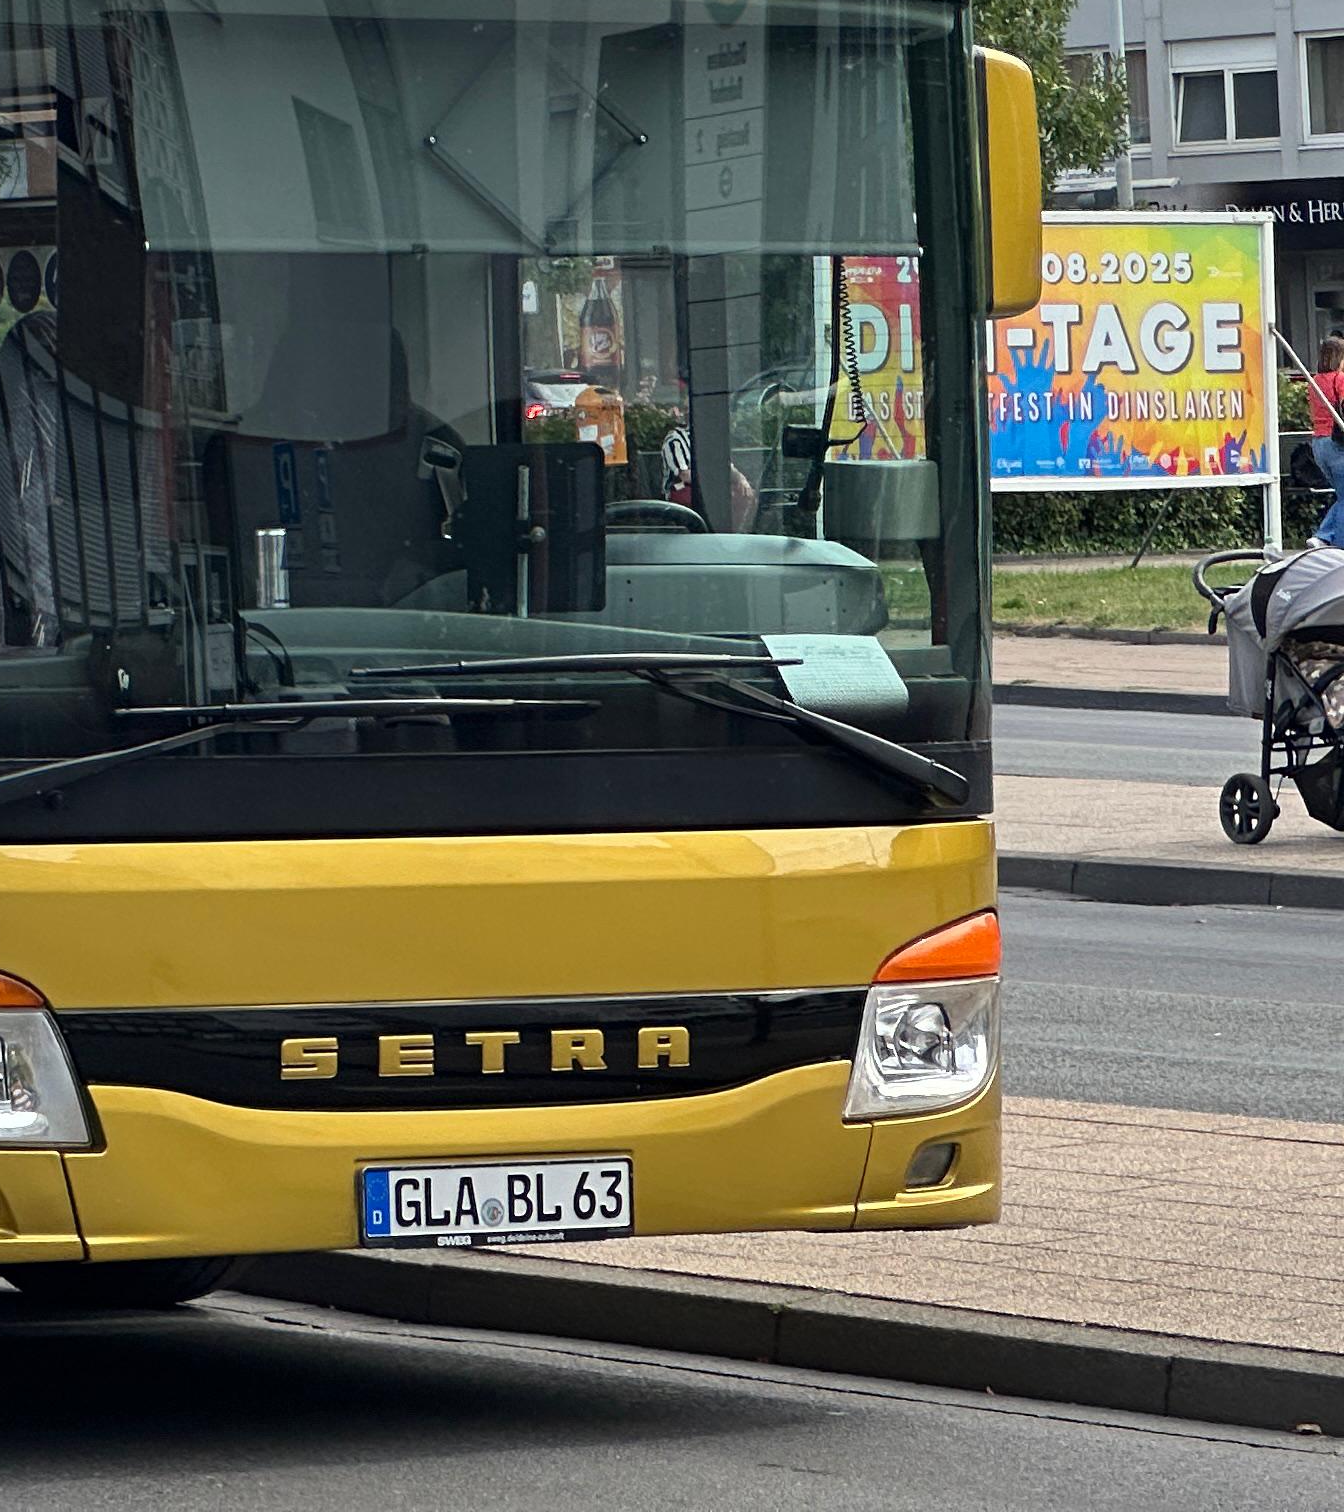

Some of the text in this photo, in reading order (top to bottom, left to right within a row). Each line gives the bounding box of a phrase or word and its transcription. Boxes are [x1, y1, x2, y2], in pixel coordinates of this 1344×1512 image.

[1308, 198, 1344, 224] HER
[848, 303, 1243, 373] DI-TAGE
[1069, 391, 1093, 420] IN
[1108, 389, 1244, 420] DINSLAKEN
[279, 1025, 692, 1081] SETRA
[372, 1170, 624, 1228] D GLA BL 63
